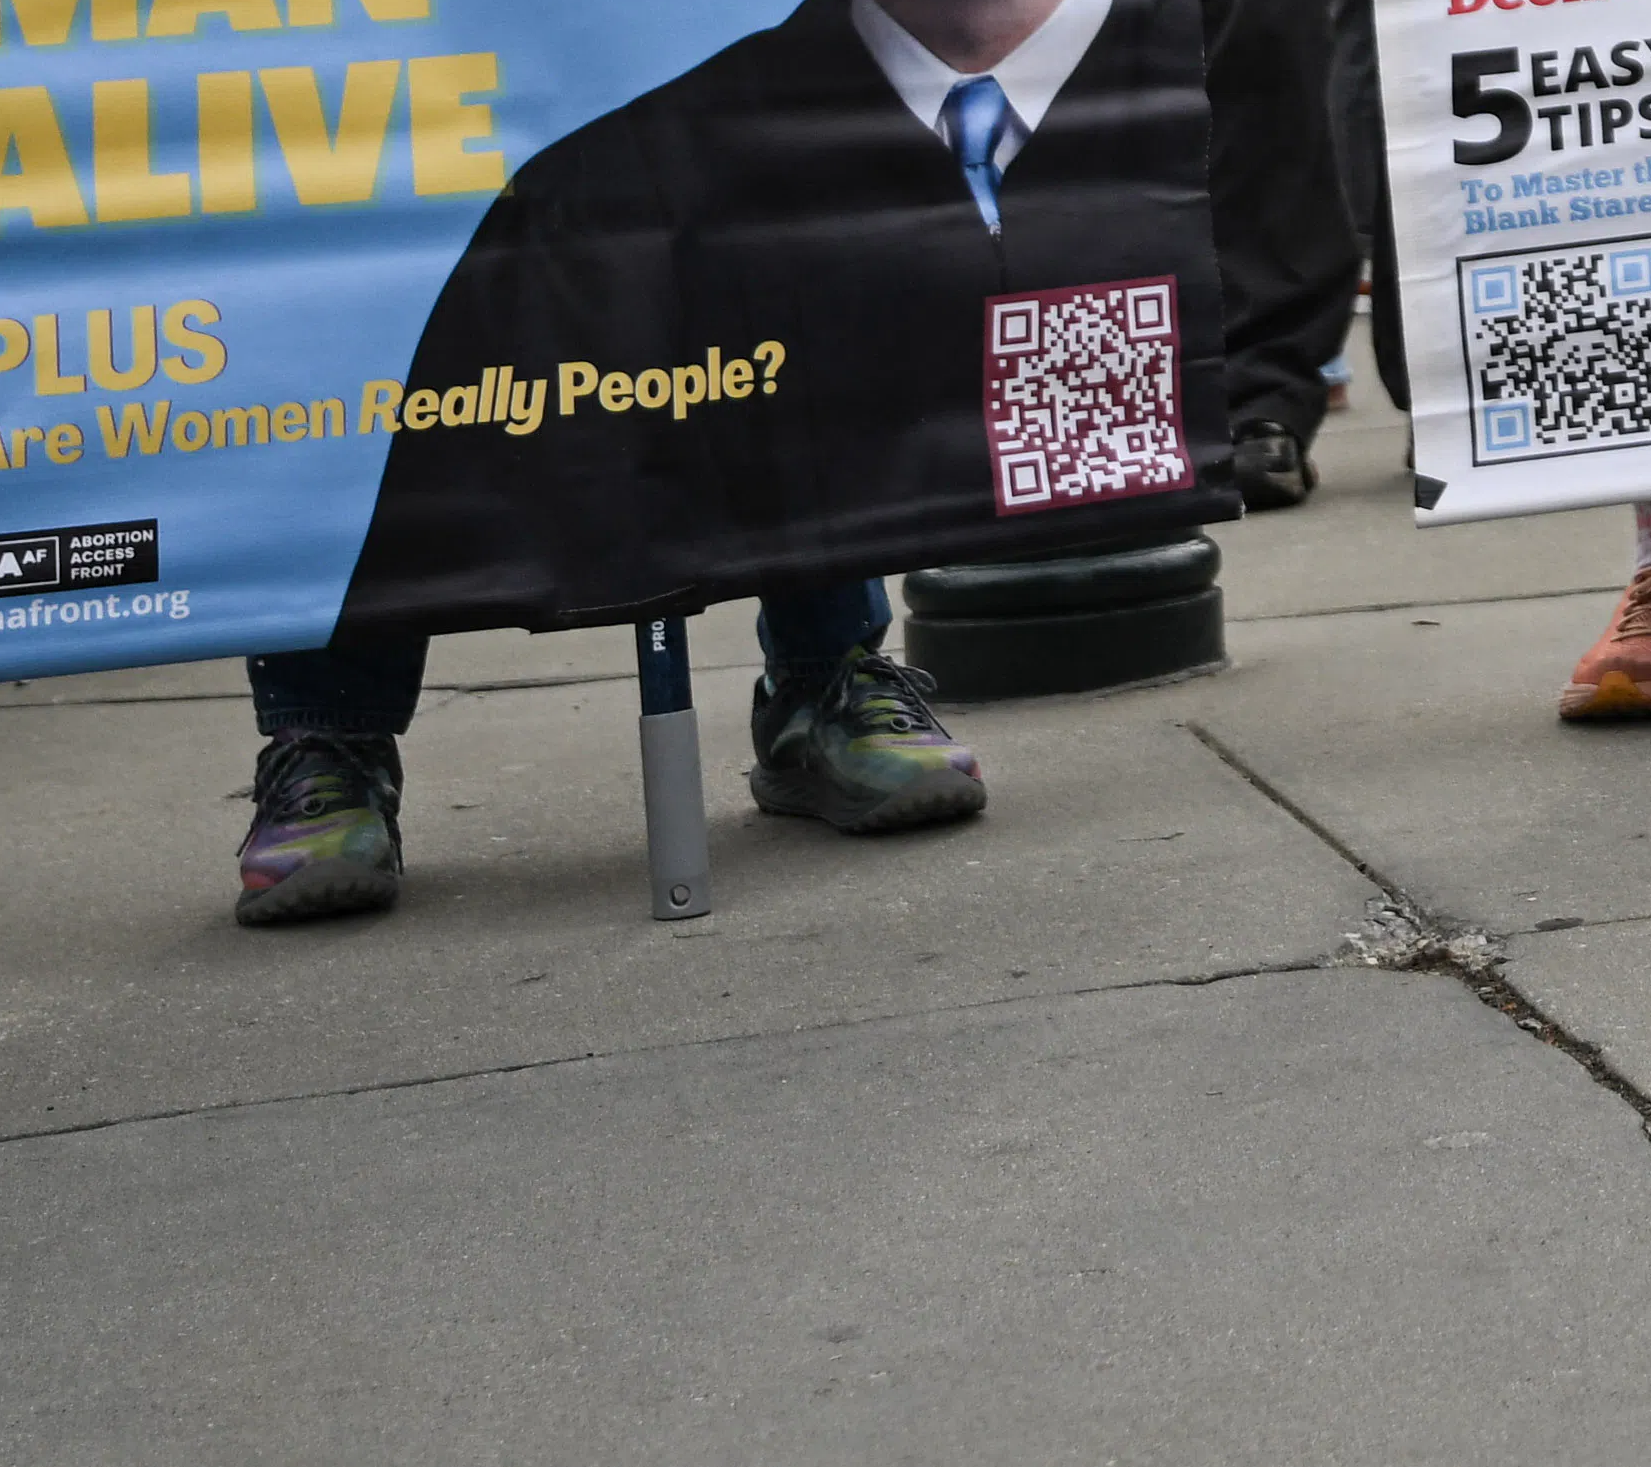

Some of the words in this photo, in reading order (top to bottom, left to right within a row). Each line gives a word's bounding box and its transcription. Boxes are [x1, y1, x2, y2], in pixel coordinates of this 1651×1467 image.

[1451, 46, 1533, 165] 5
[1461, 178, 1504, 205] To
[1511, 167, 1625, 198] Master
[1463, 200, 1561, 235] Blank
[100, 395, 347, 458] Women
[358, 363, 548, 436] Really
[558, 340, 787, 417] People?
[70, 529, 154, 549] ABORTION
[70, 546, 135, 564] ACCESS
[71, 564, 125, 580] FRONT
